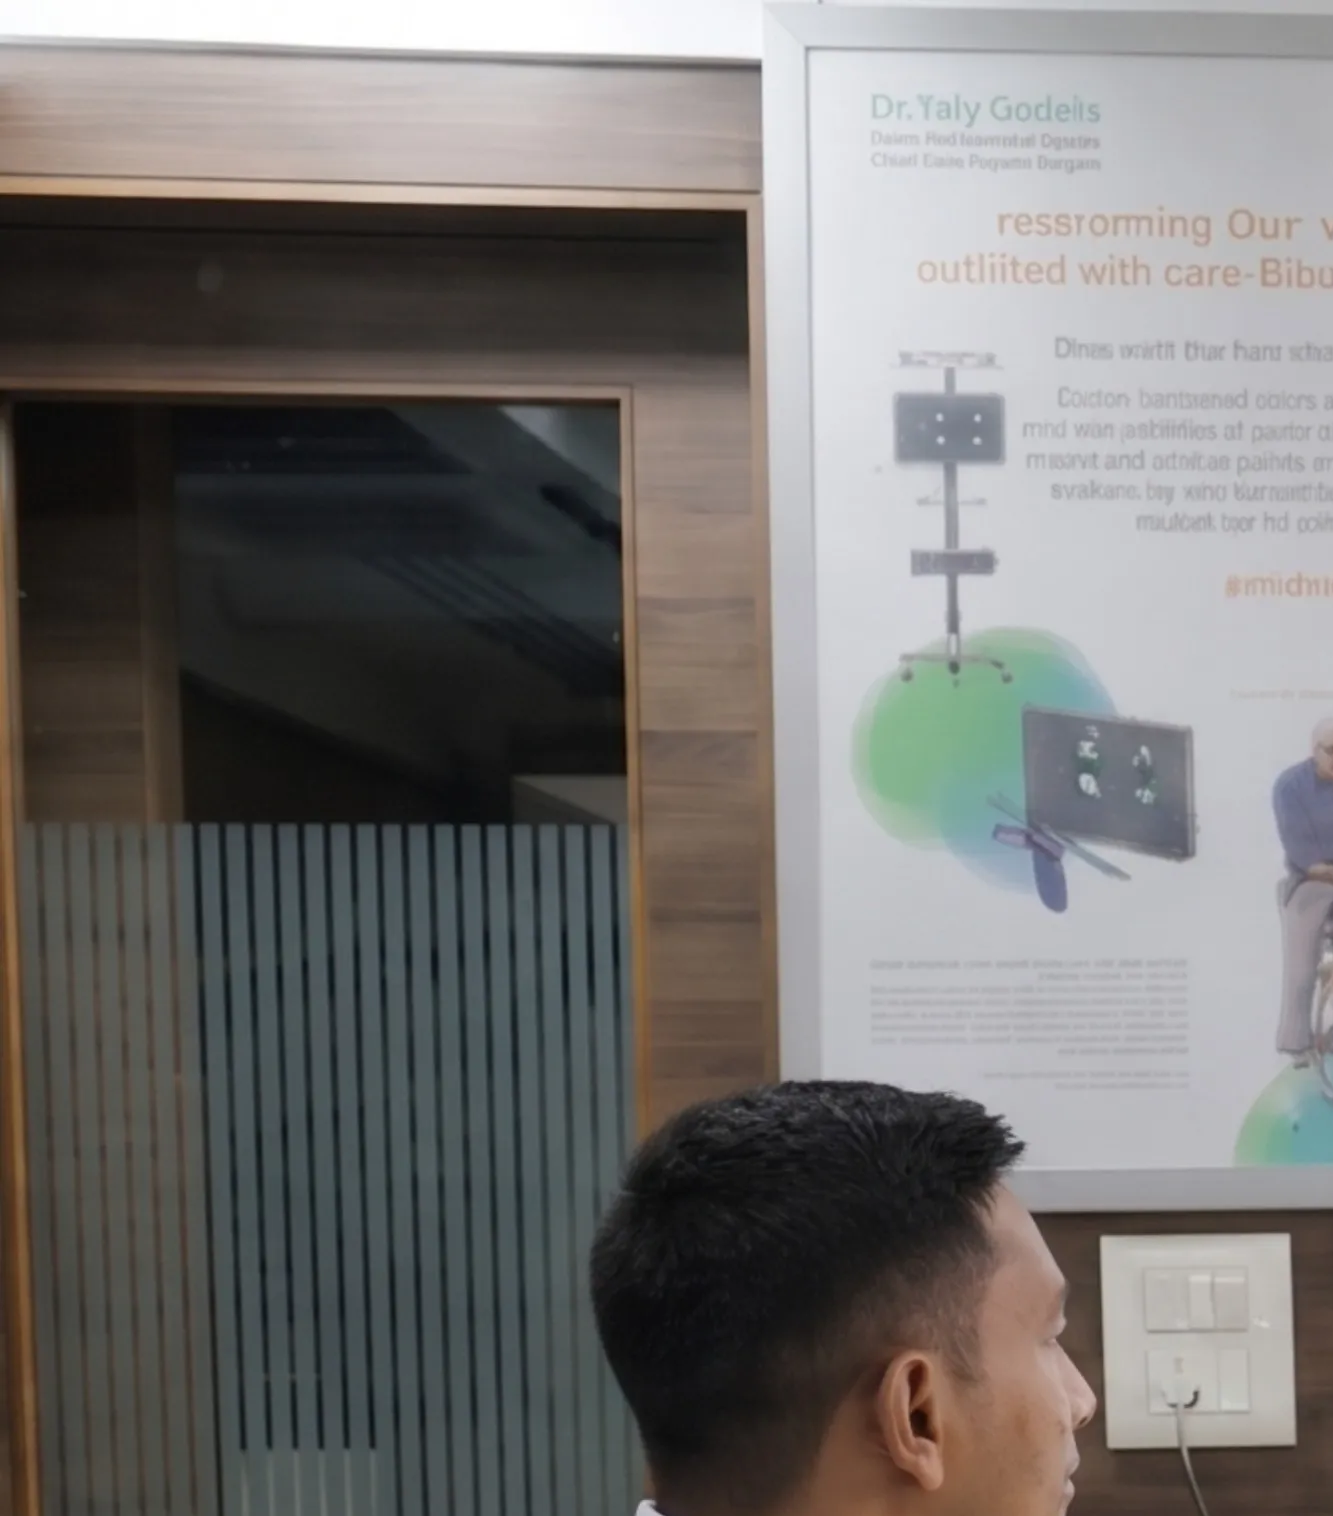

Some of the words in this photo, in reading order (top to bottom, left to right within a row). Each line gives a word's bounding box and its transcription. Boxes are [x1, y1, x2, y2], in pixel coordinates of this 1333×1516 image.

[1227, 208, 1303, 241] Our
[1077, 253, 1151, 287] with
[1104, 449, 1146, 471] and
